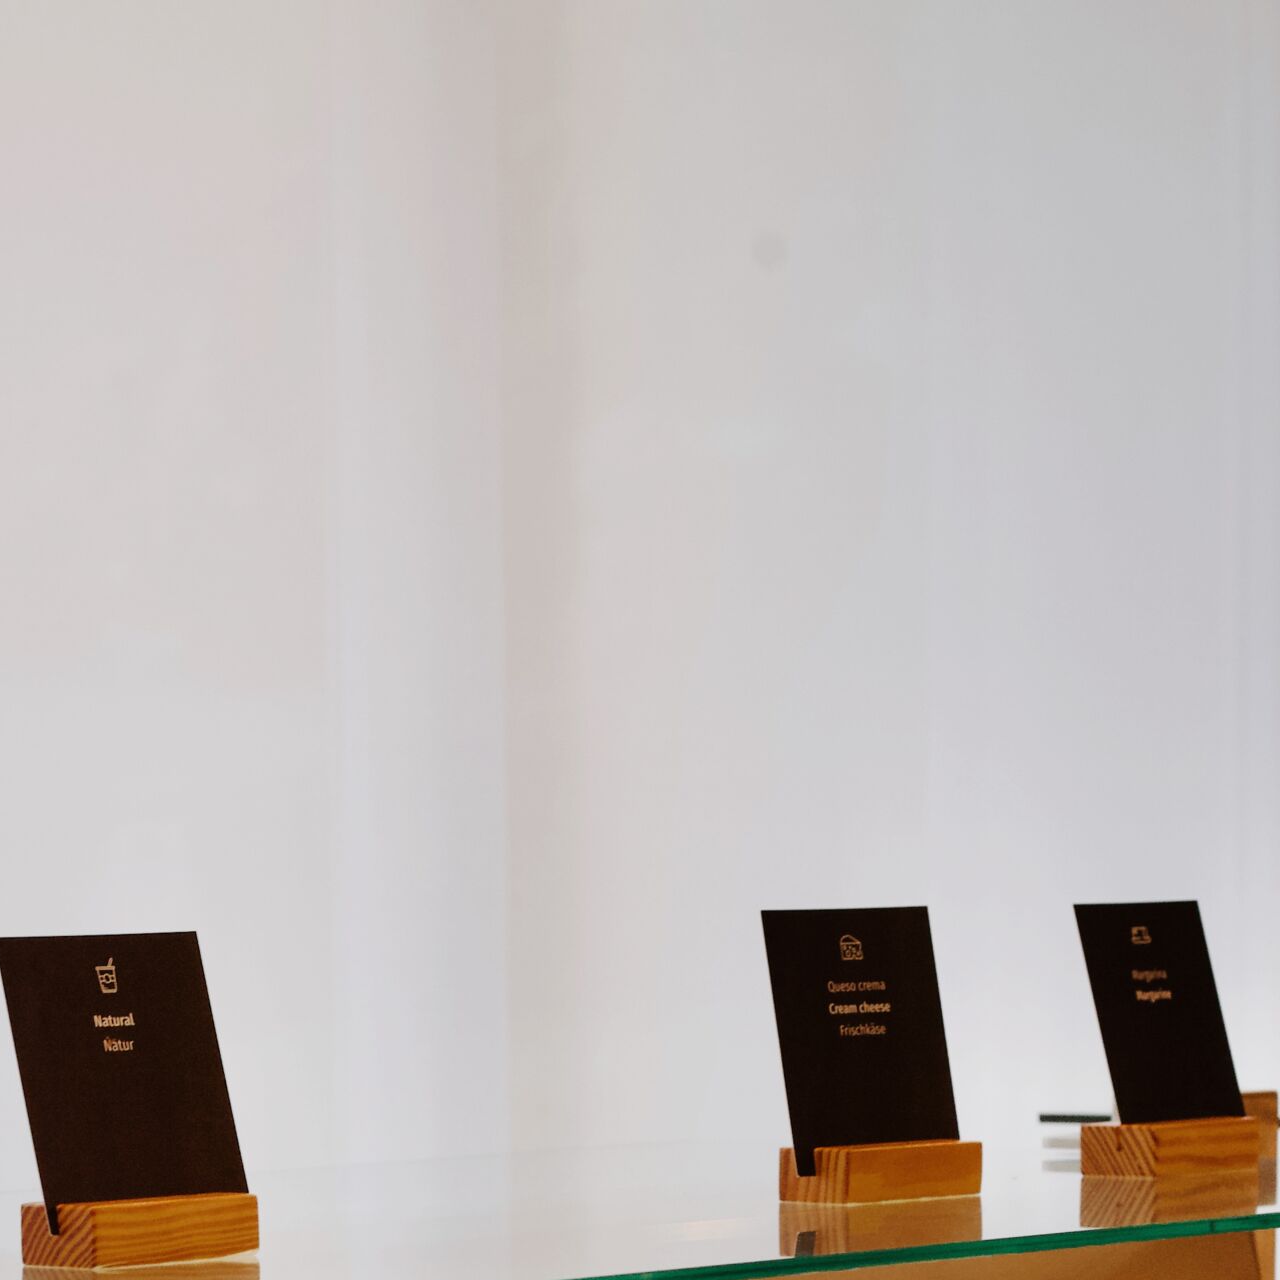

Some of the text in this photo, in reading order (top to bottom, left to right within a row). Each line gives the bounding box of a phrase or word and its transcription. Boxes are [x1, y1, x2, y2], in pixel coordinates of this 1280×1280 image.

[827, 981, 886, 993] Queso crema
[828, 1001, 891, 1014] Cream cheese
[93, 1012, 135, 1028] Natural
[840, 1022, 886, 1036] Frischkäse
[103, 1039, 134, 1052] Natur
